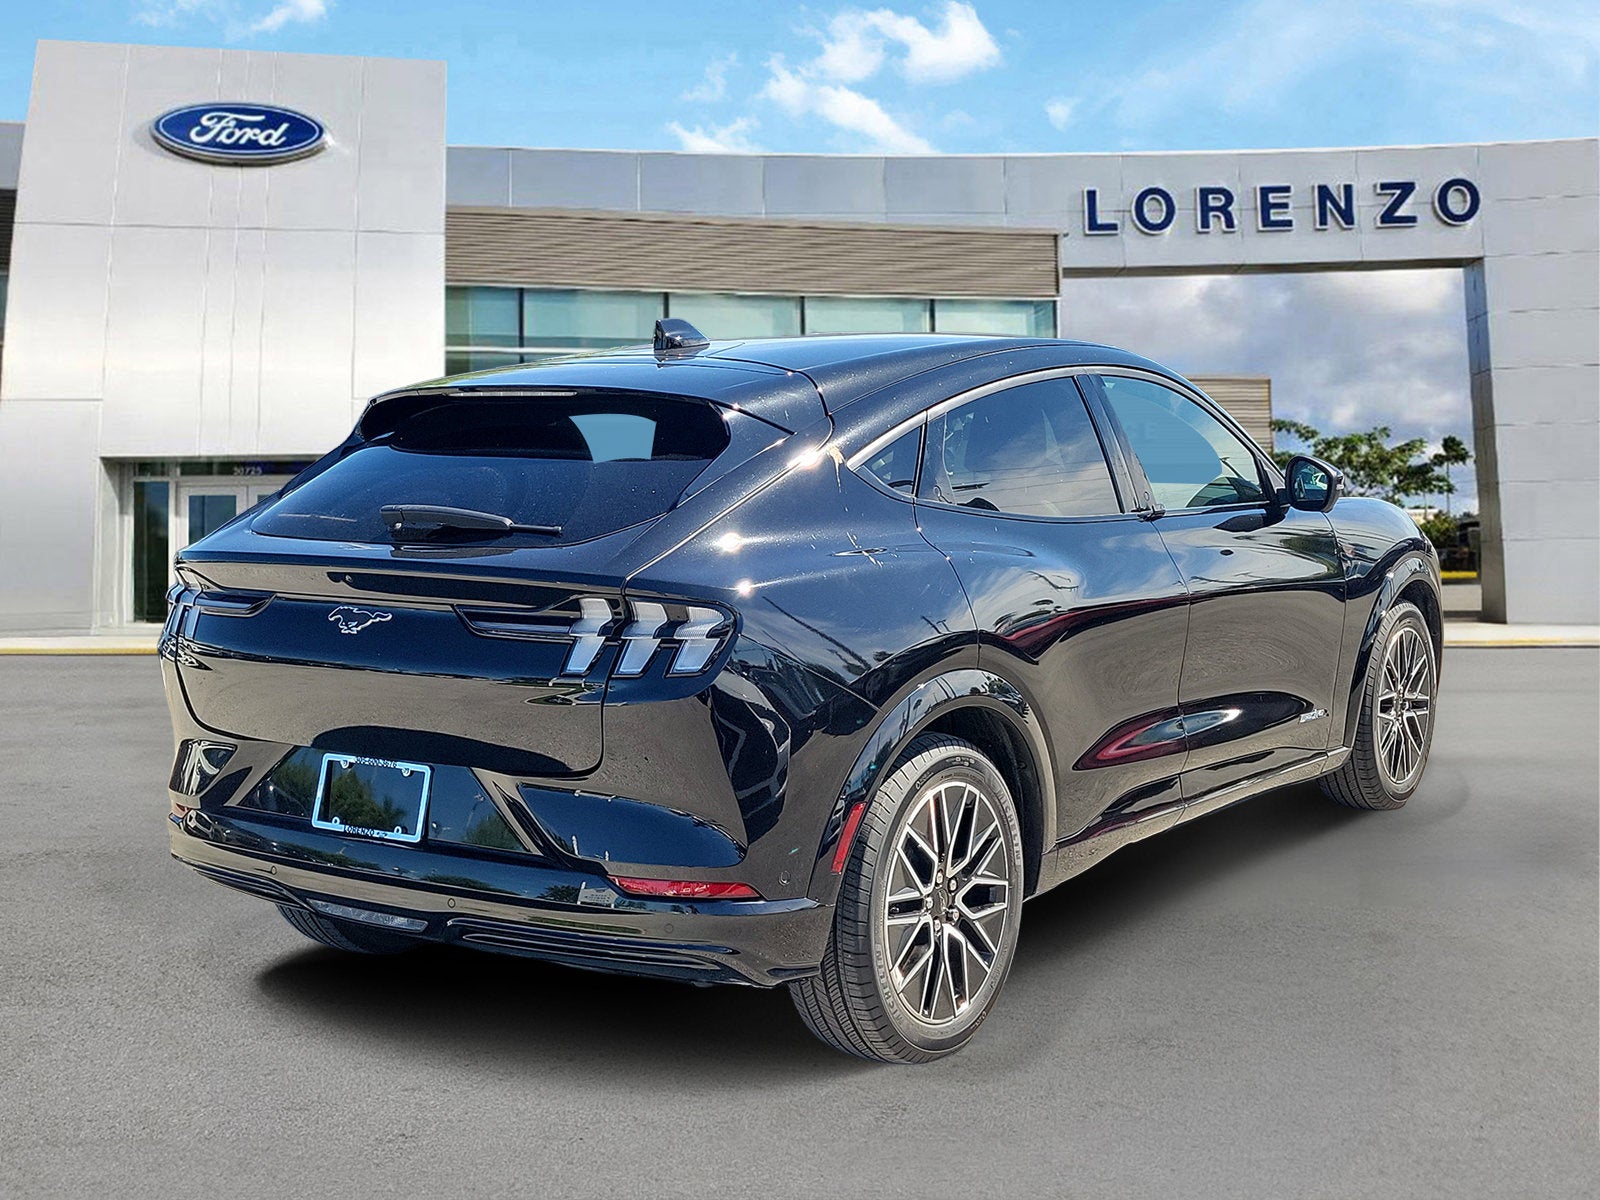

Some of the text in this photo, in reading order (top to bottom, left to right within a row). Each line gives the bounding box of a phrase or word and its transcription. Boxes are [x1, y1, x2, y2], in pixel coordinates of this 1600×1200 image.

[190, 111, 290, 146] Ford
[1084, 177, 1480, 235] LORENZO
[344, 824, 375, 837] LORENZO
[997, 789, 1022, 861] MICHELIN
